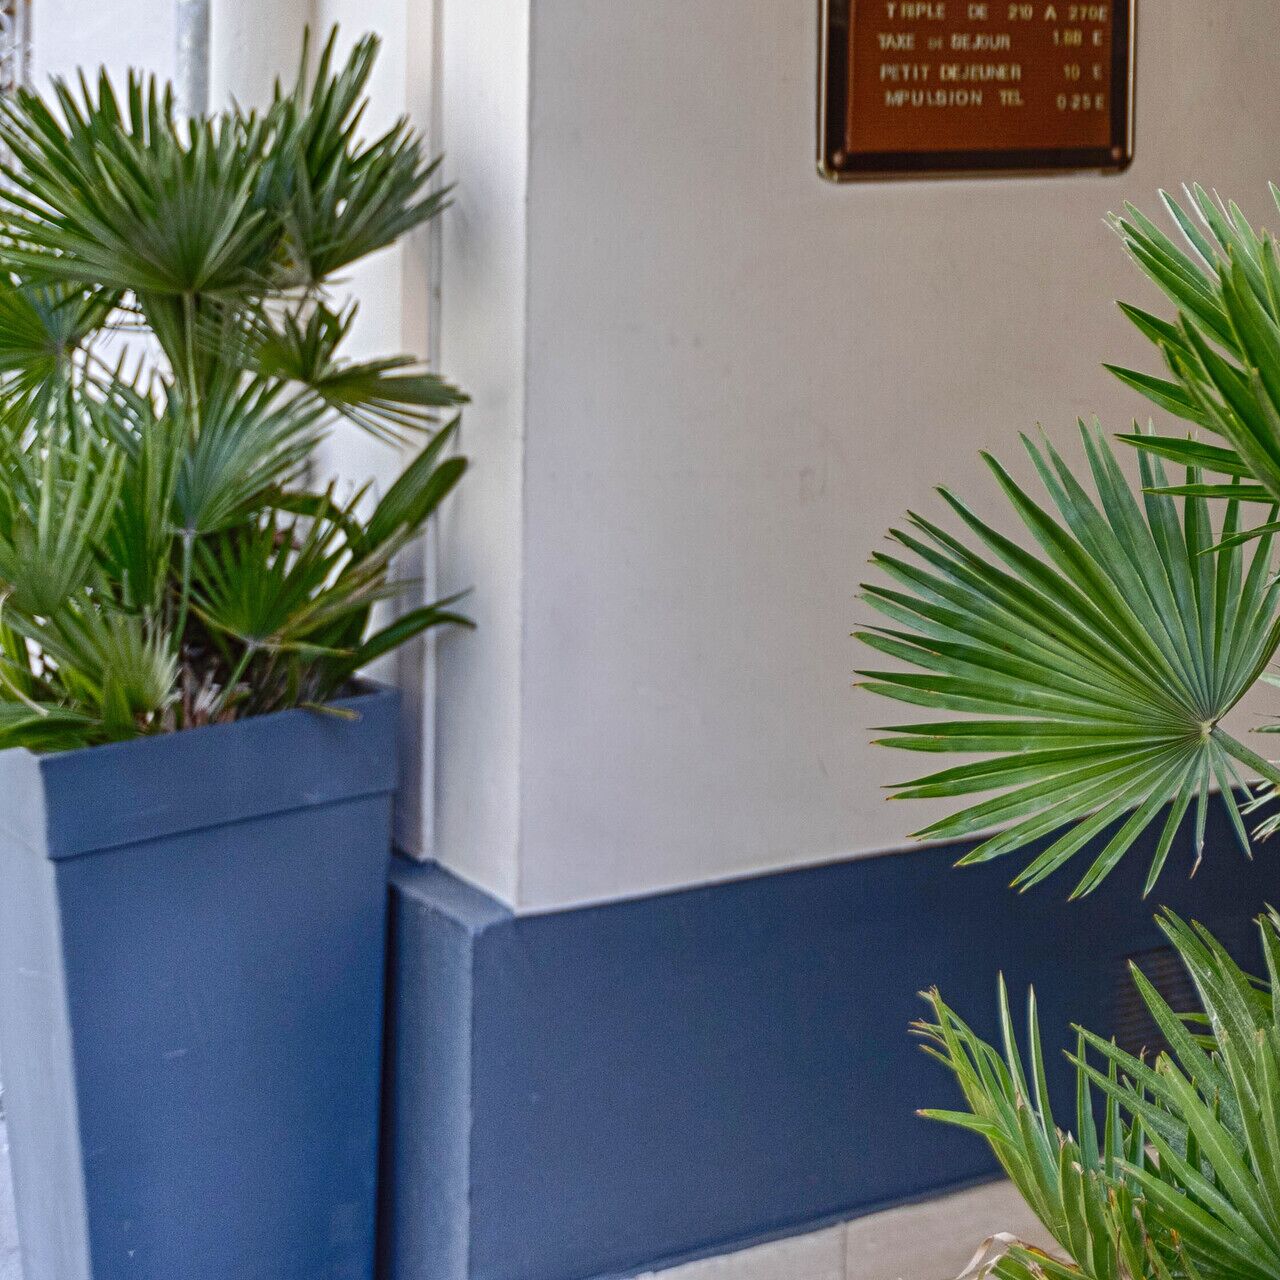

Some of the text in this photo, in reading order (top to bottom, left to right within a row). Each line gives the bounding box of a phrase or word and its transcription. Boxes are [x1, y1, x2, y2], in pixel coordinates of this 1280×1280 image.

[967, 2, 988, 21] DE
[1045, 4, 1058, 22] A
[879, 33, 915, 51] TAXE
[951, 32, 1011, 52] SEJOUR
[880, 62, 930, 82] PETIT
[940, 62, 1022, 82] DEJEUNER
[1063, 63, 1081, 81] 10
